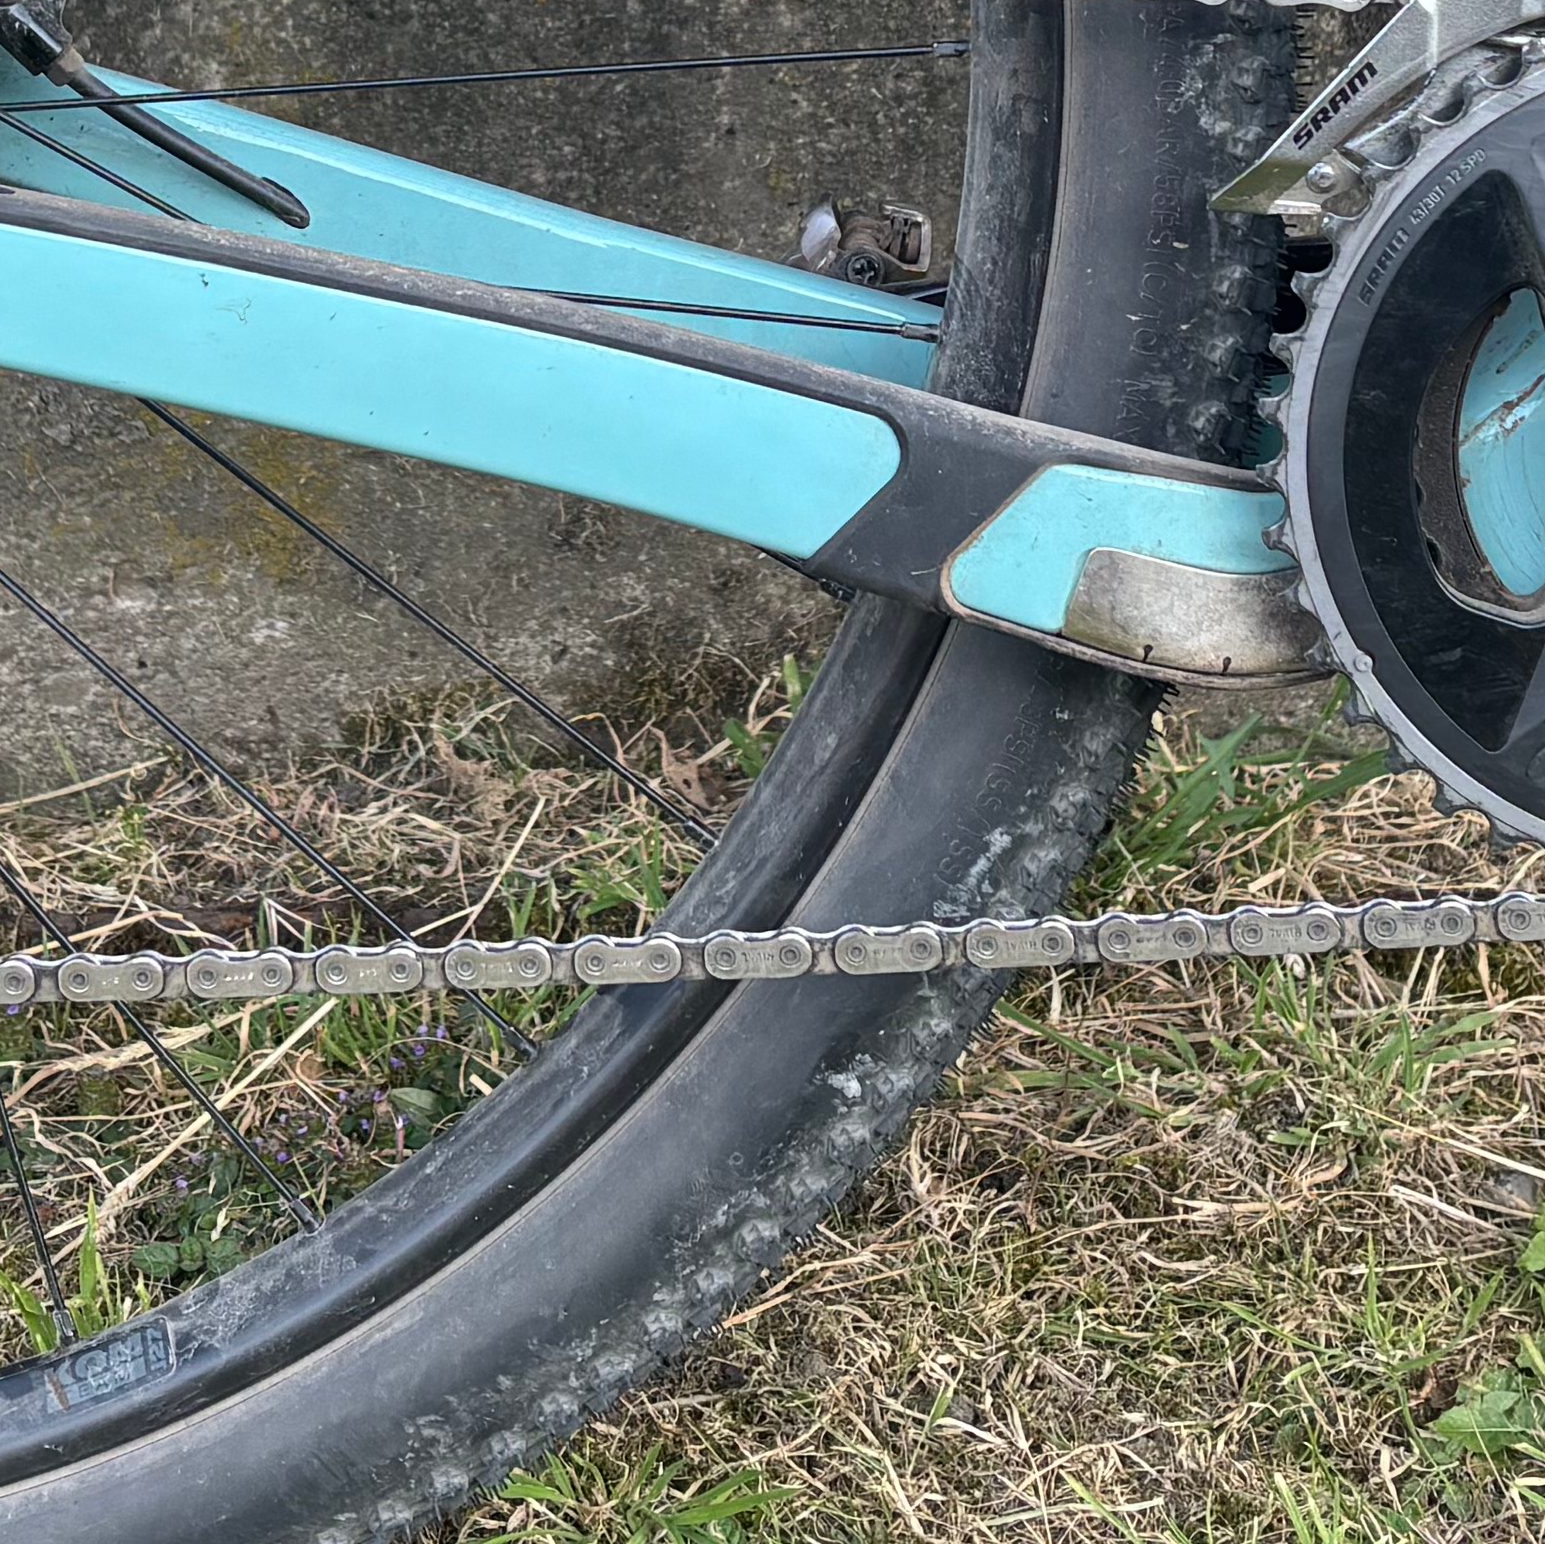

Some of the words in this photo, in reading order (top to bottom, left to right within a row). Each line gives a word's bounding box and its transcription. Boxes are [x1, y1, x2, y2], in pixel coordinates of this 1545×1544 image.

[1292, 60, 1379, 151] SRAM
[1409, 184, 1446, 225] 43/30T
[1445, 171, 1462, 187] 12
[1461, 147, 1487, 176] SPD
